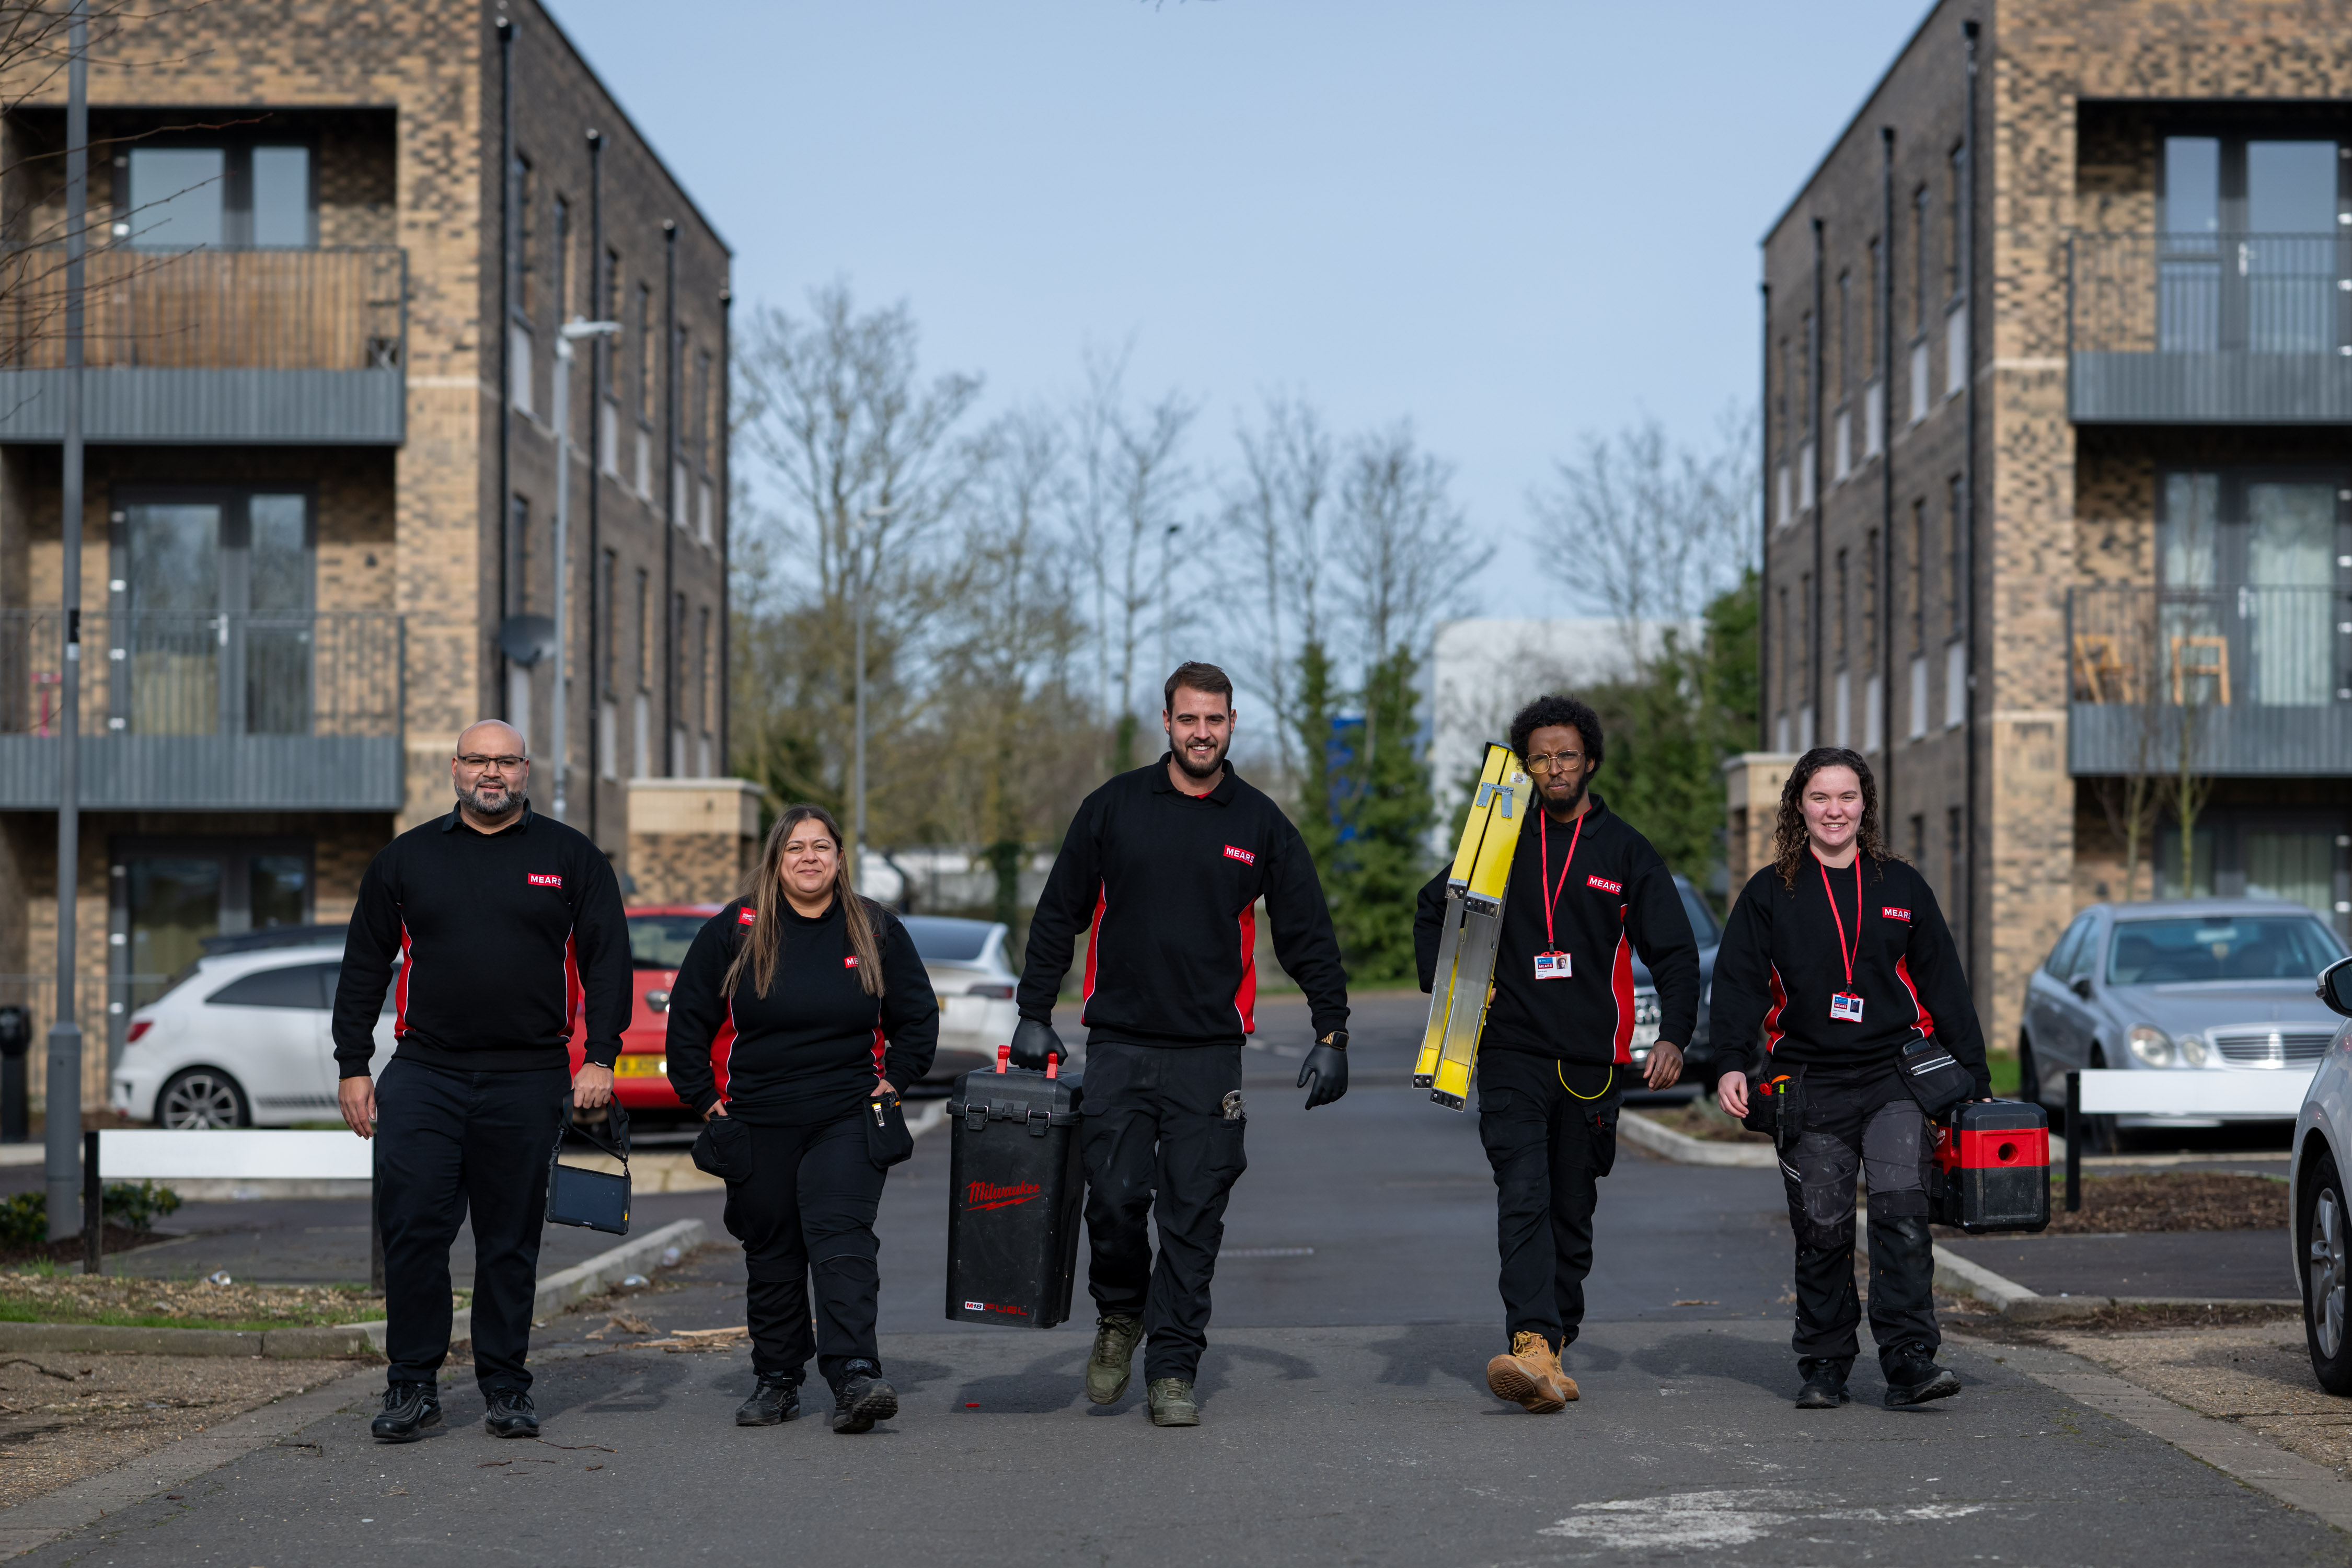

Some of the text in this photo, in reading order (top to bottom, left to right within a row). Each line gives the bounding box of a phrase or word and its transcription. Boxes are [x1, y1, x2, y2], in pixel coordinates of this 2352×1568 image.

[1226, 847, 1254, 863] MEARS
[531, 875, 562, 886] MEARS
[1589, 877, 1621, 892] MEARS
[965, 1180, 1041, 1204] Milwaukee
[985, 1303, 1028, 1316] FUEL
